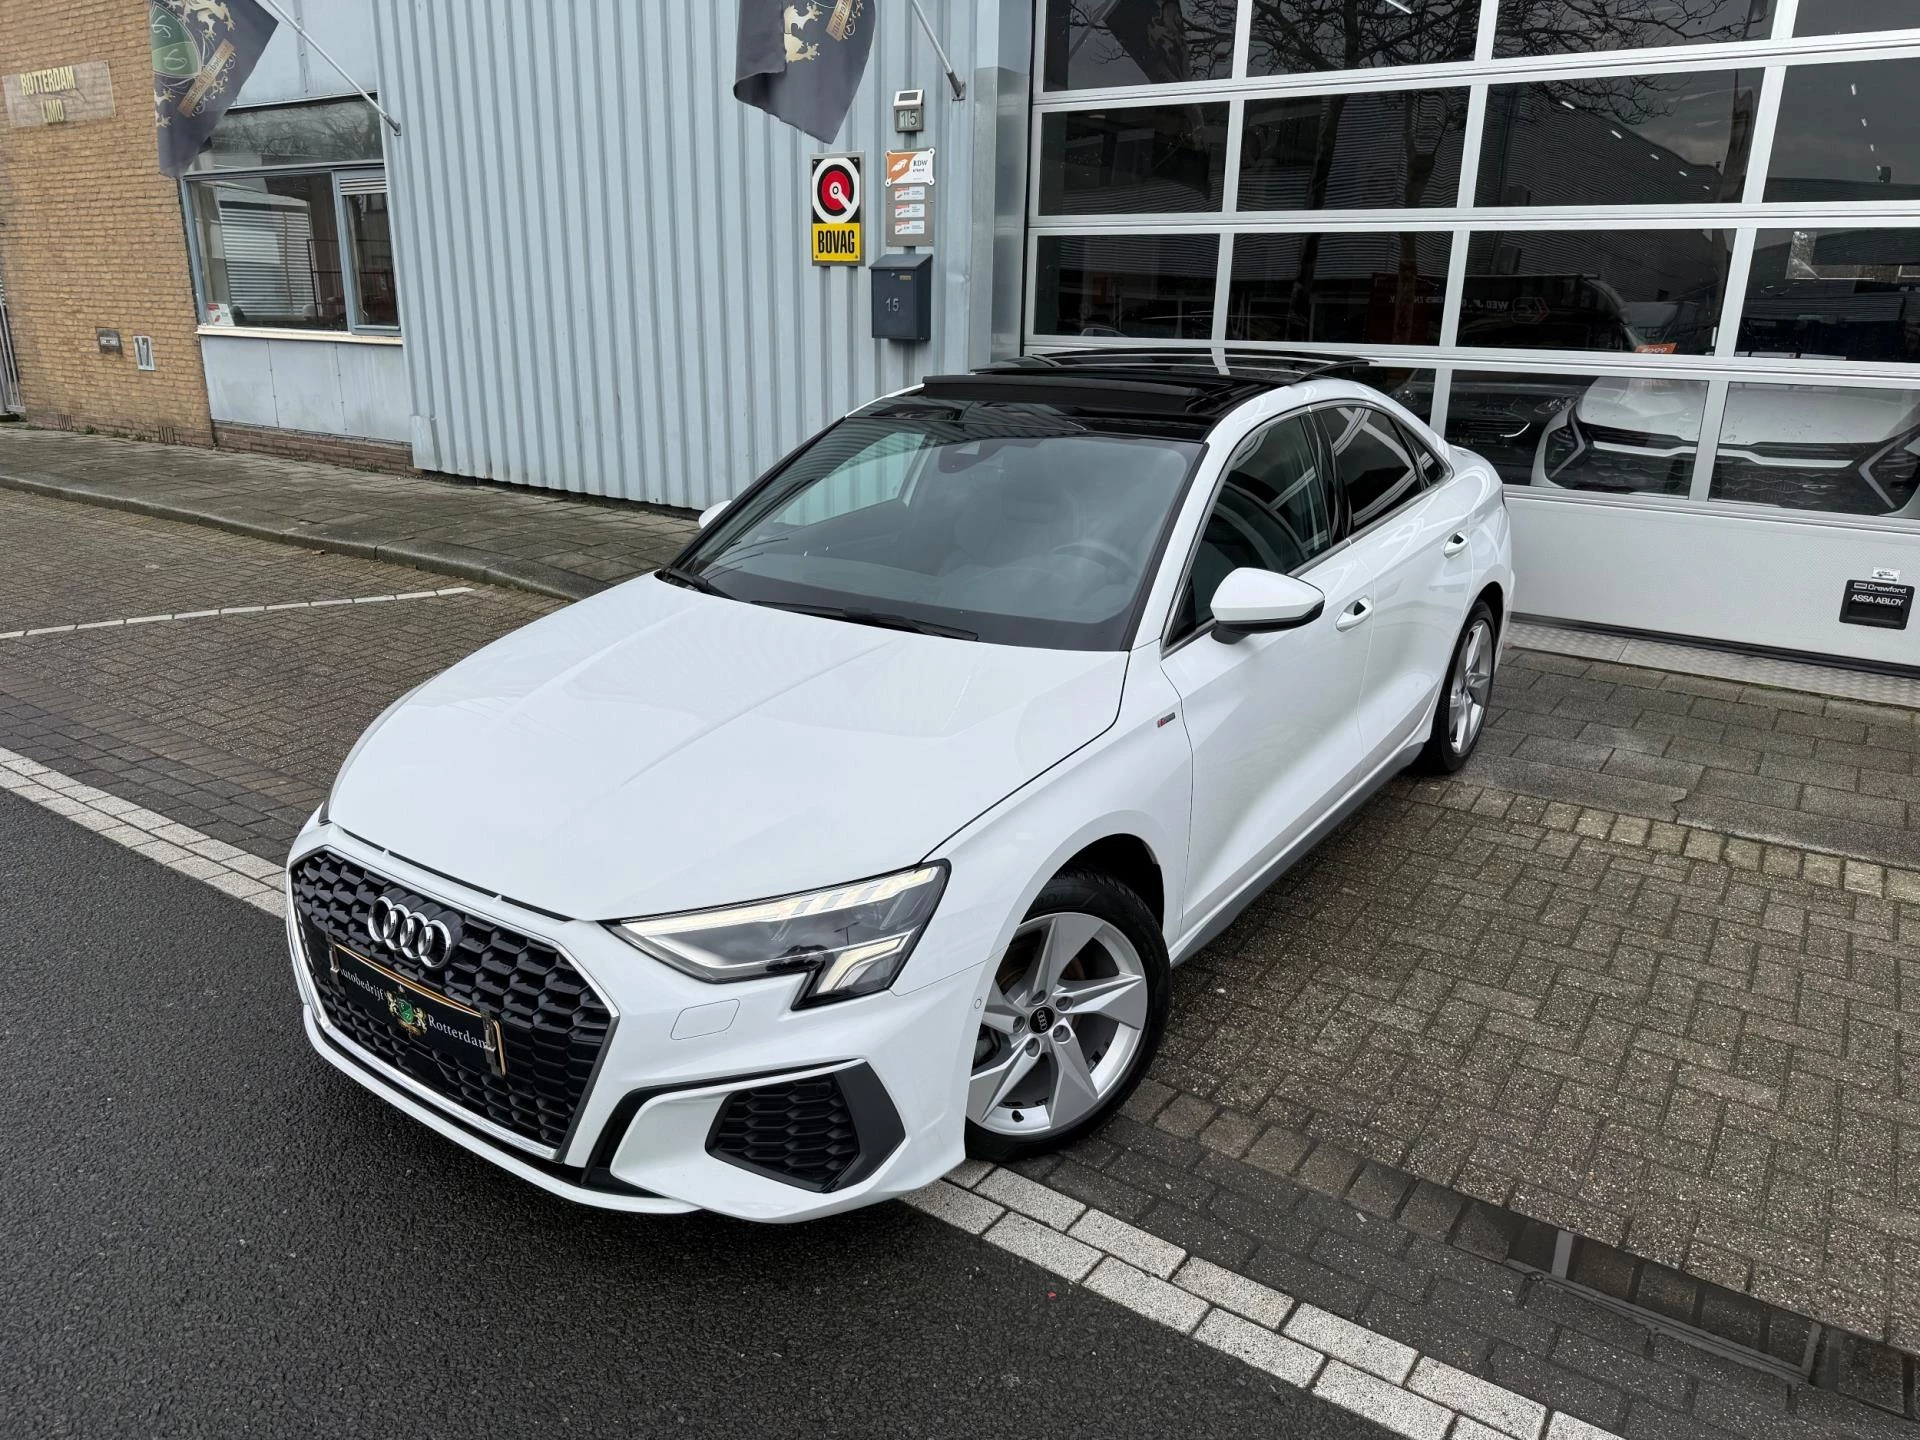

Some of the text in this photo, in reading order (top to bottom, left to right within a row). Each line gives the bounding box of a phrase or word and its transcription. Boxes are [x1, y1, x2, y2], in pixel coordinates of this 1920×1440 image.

[20, 65, 76, 96] ROTTERDAM
[40, 98, 65, 123] LIMO
[901, 111, 917, 126] 15
[817, 229, 855, 254] BOVAG
[885, 297, 900, 312] 15
[135, 337, 150, 366] 17
[1867, 583, 1907, 594] Crawford
[1851, 594, 1904, 607] ASSA ABLOY
